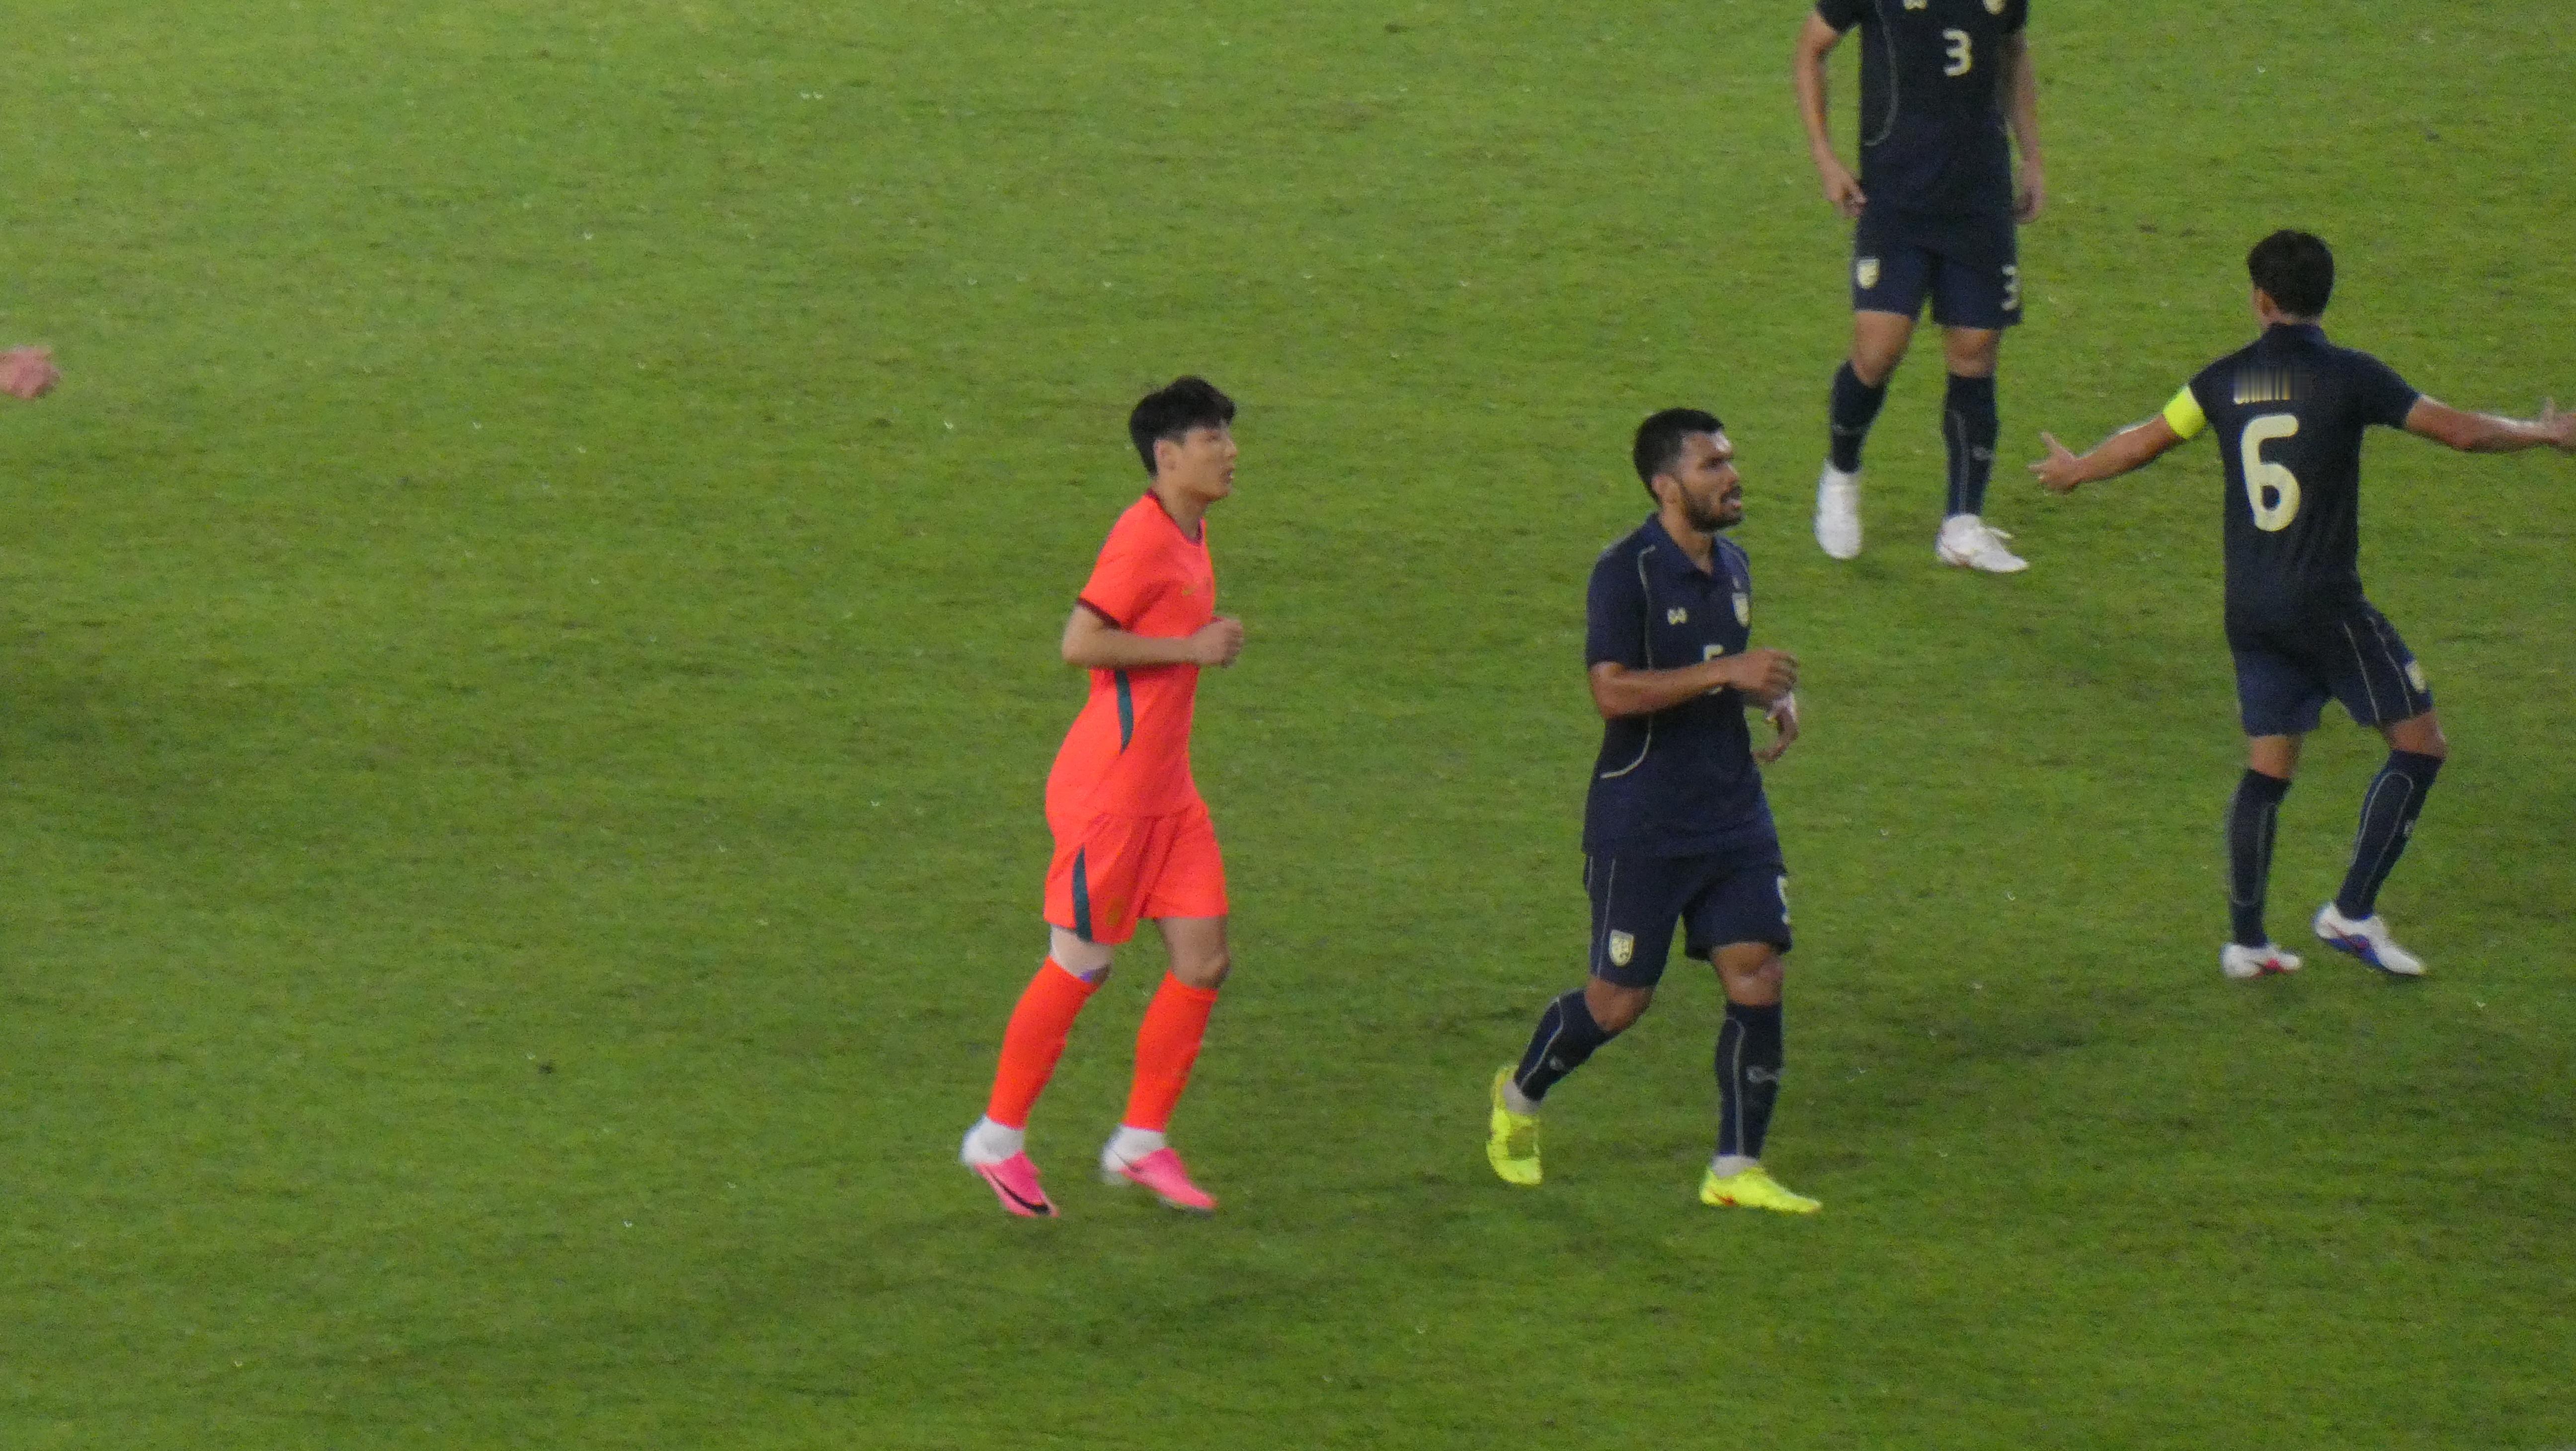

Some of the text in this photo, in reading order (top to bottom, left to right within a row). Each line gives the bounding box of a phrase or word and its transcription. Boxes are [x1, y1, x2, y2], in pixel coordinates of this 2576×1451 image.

[1942, 28, 1972, 77] 3
[2001, 265, 2021, 311] 3
[2241, 413, 2301, 532] 6
